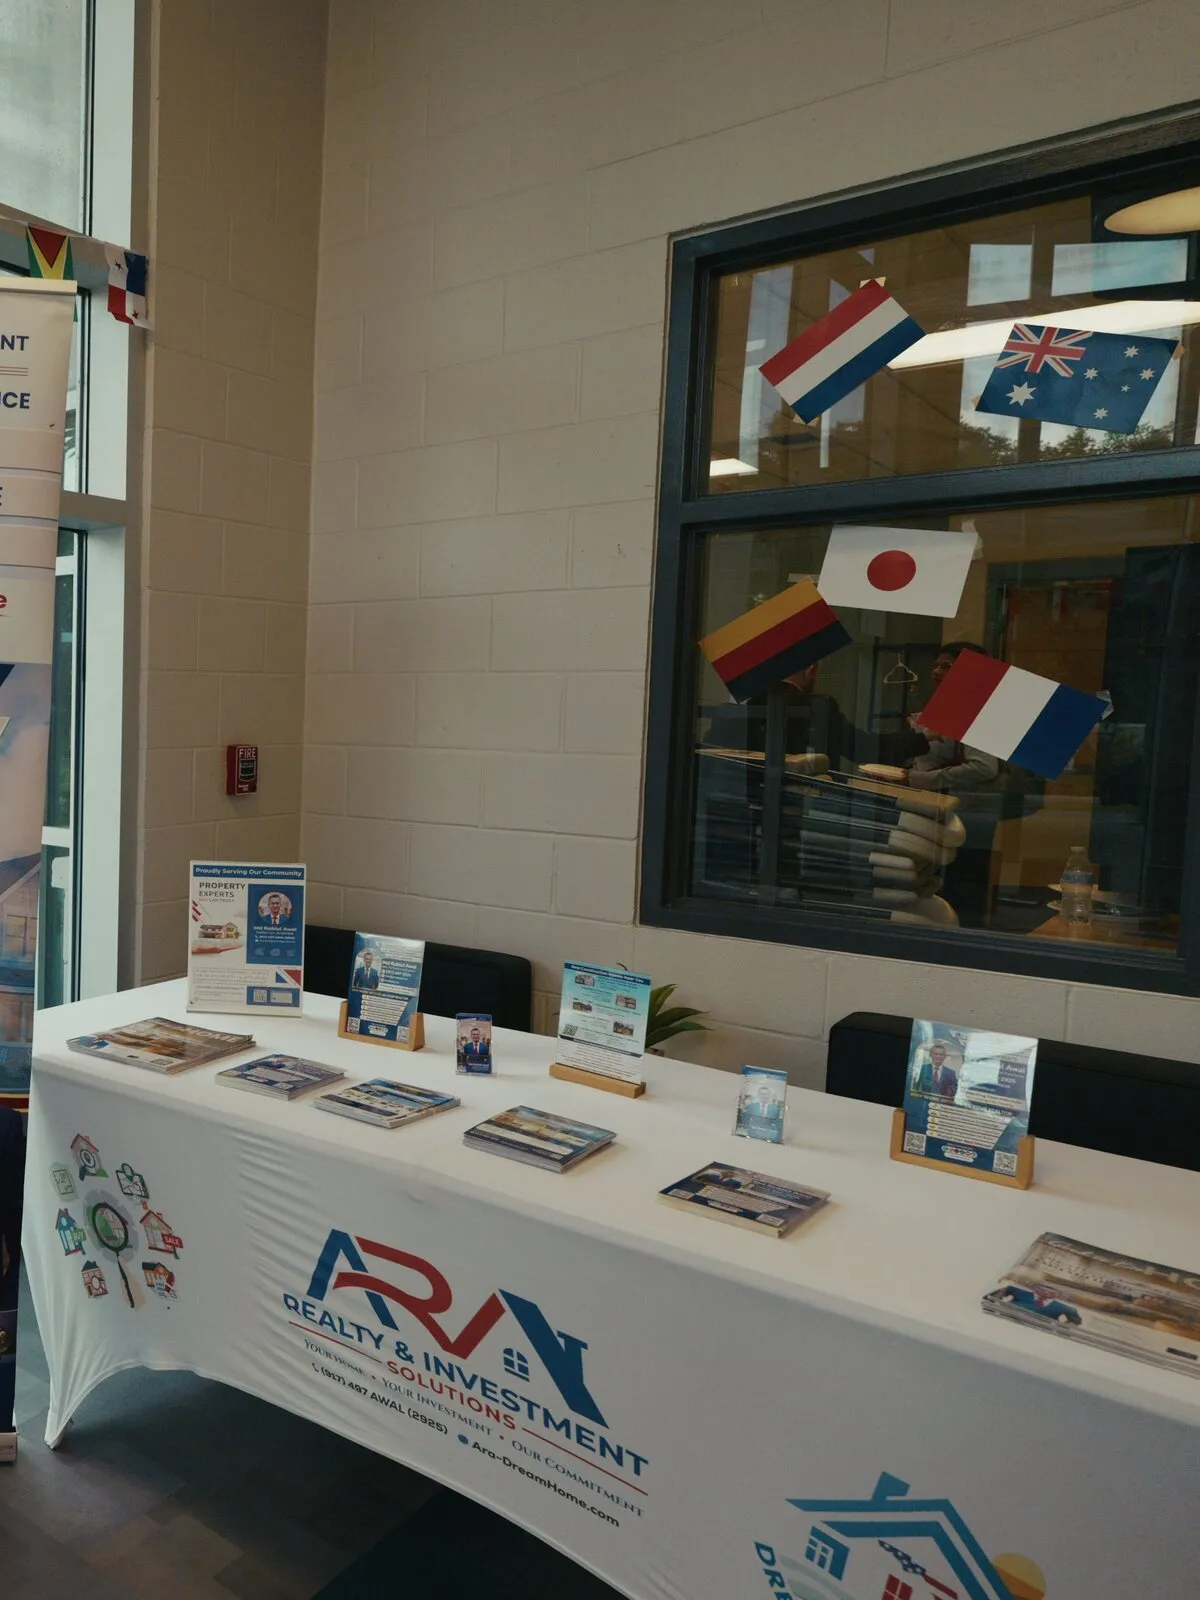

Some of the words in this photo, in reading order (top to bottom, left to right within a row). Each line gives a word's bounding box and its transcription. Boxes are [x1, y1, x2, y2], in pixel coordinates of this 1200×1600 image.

[239, 748, 256, 758] FIRE
[199, 882, 245, 890] PROPERTY
[223, 868, 247, 876] Serving
[163, 1235, 181, 1246] SALE
[283, 1293, 384, 1350] REALTY
[395, 1341, 414, 1363] &
[424, 1352, 648, 1477] INVESTMENT
[387, 1361, 516, 1430] SOLUTIONS
[321, 1367, 346, 1386] (917)
[348, 1381, 368, 1396] 497
[370, 1392, 405, 1415] AWAL
[408, 1408, 448, 1435] (2925)
[472, 1441, 620, 1527] Ara-DreamHome.com
[416, 1392, 493, 1436] INVESTMENT
[512, 1440, 540, 1464] OUR
[545, 1456, 644, 1518] COMMITMENT
